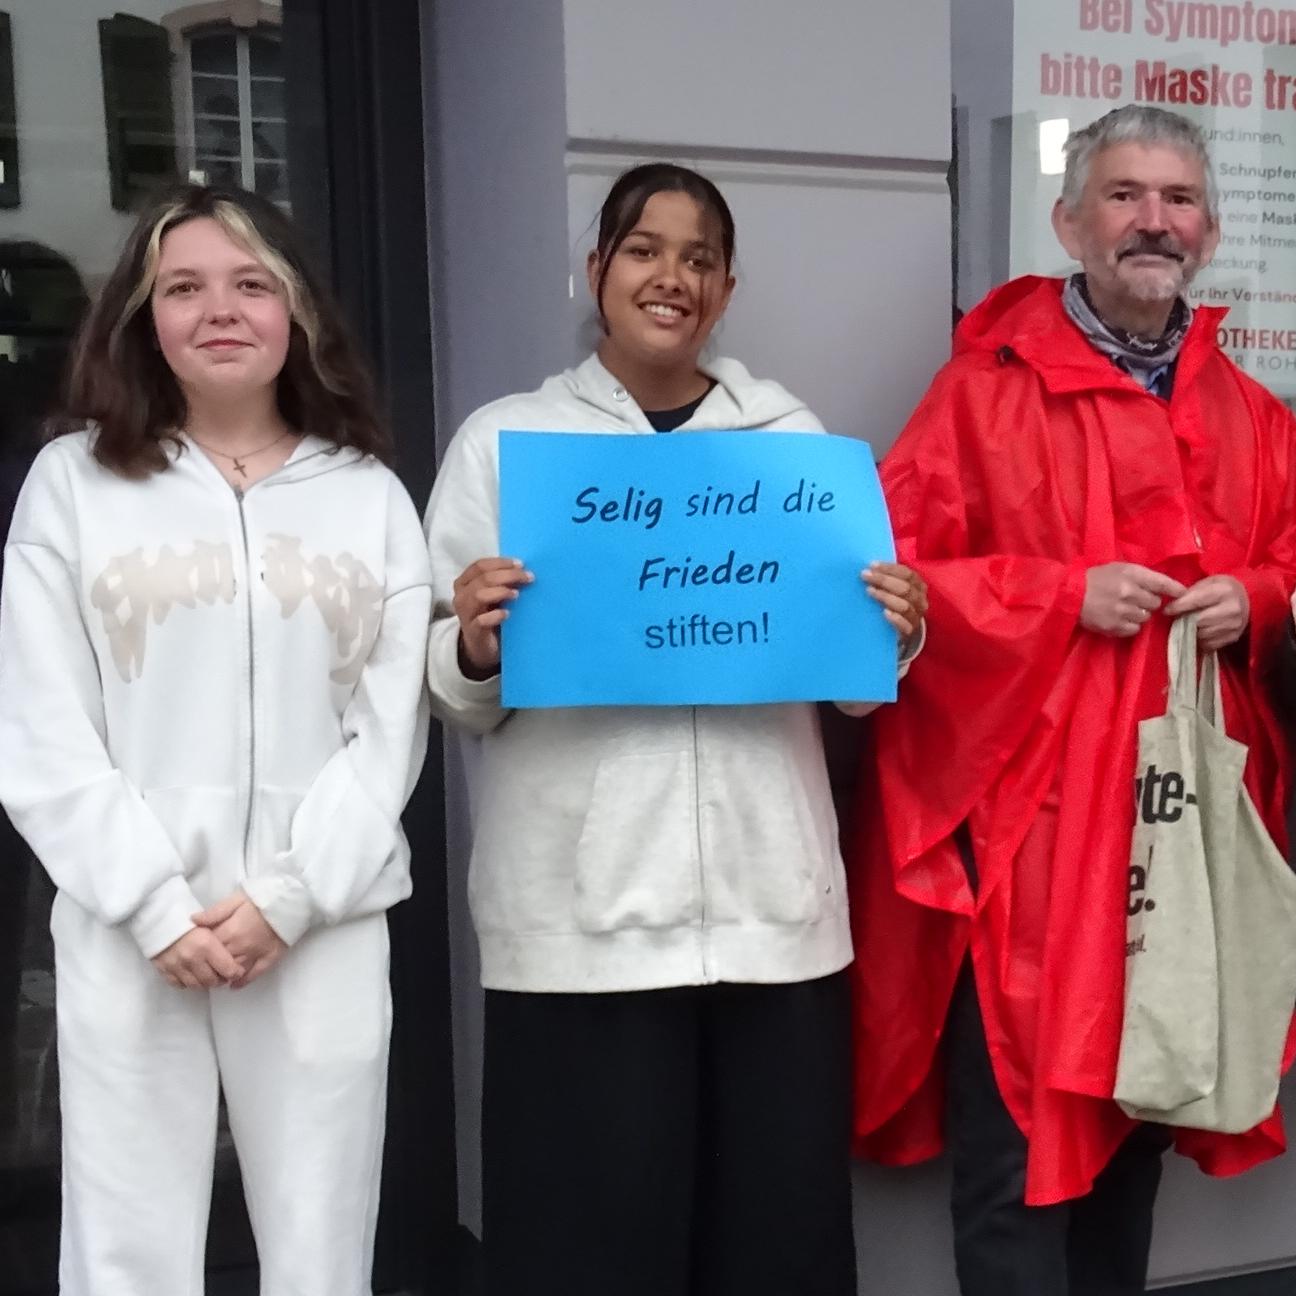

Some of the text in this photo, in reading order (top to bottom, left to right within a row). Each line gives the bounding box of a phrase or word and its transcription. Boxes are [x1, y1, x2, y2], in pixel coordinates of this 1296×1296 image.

[1040, 53, 1122, 99] bitte
[1135, 60, 1252, 107] Maske
[1222, 188, 1296, 204] ymptome
[1208, 286, 1228, 300] Ihr
[572, 479, 836, 529] Selig sind die
[639, 550, 780, 591] Frieden
[645, 612, 769, 649] stiften!
